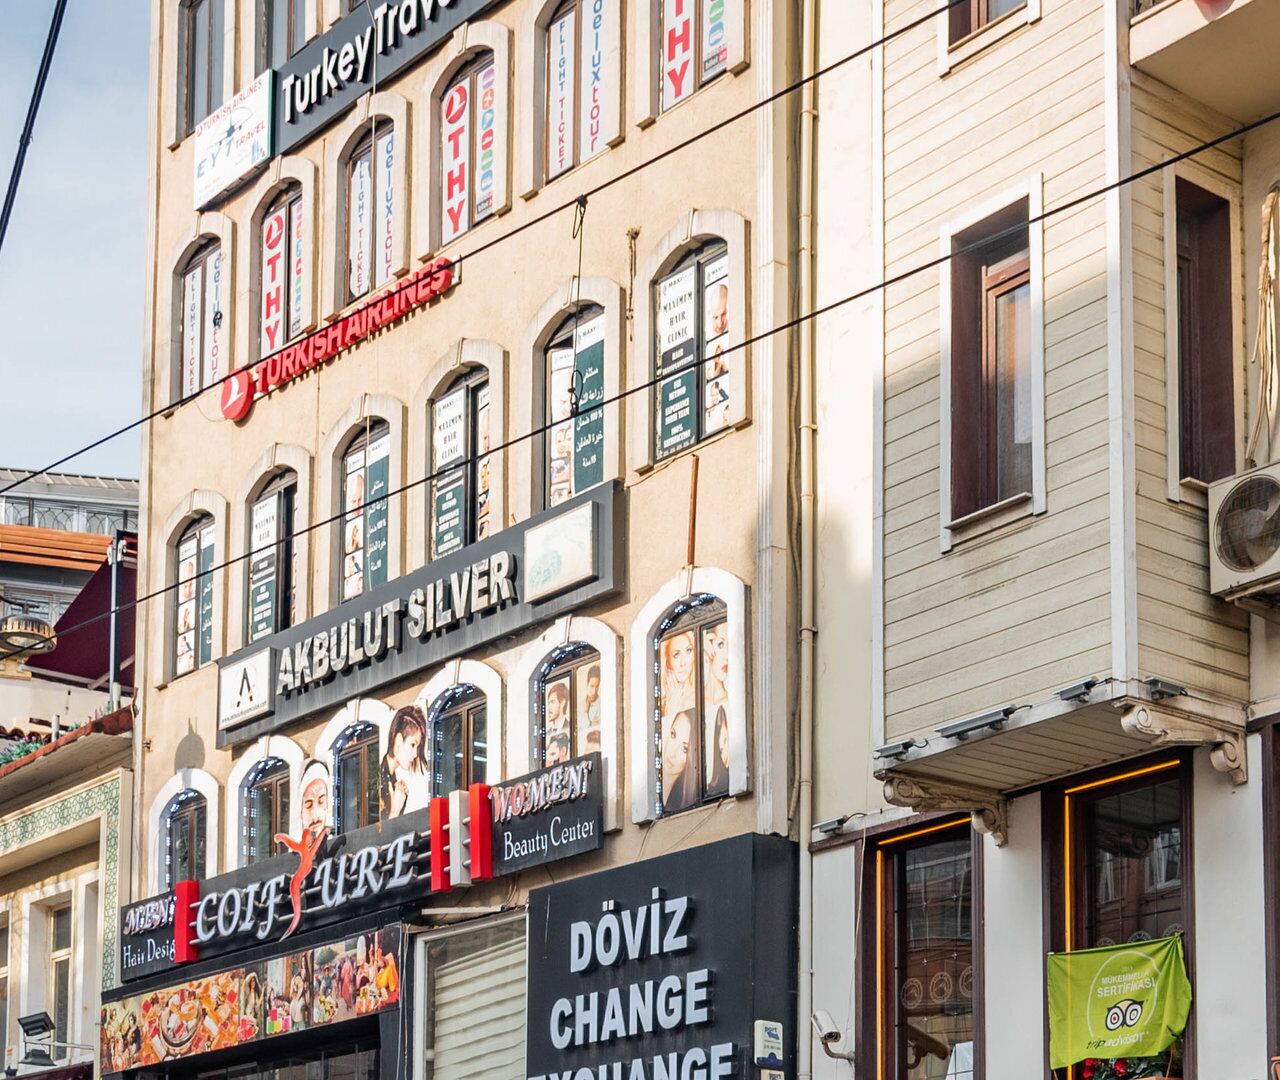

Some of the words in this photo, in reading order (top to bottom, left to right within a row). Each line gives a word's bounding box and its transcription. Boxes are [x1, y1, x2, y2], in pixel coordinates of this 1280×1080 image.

[282, 26, 373, 123] Turkey
[374, 0, 452, 54] Trav
[557, 97, 565, 169] TICKET
[447, 131, 468, 234] THY
[255, 318, 348, 390] TURKISH
[343, 257, 452, 343] AIRLINES
[265, 252, 281, 349] THY
[276, 598, 404, 697] AKBULUT
[407, 549, 516, 642] SILVER
[503, 829, 548, 861] Beauty
[550, 816, 595, 846] Center
[123, 945, 145, 968] Hair
[570, 886, 688, 973] DÖVİZ
[550, 968, 709, 1050] CHANGE
